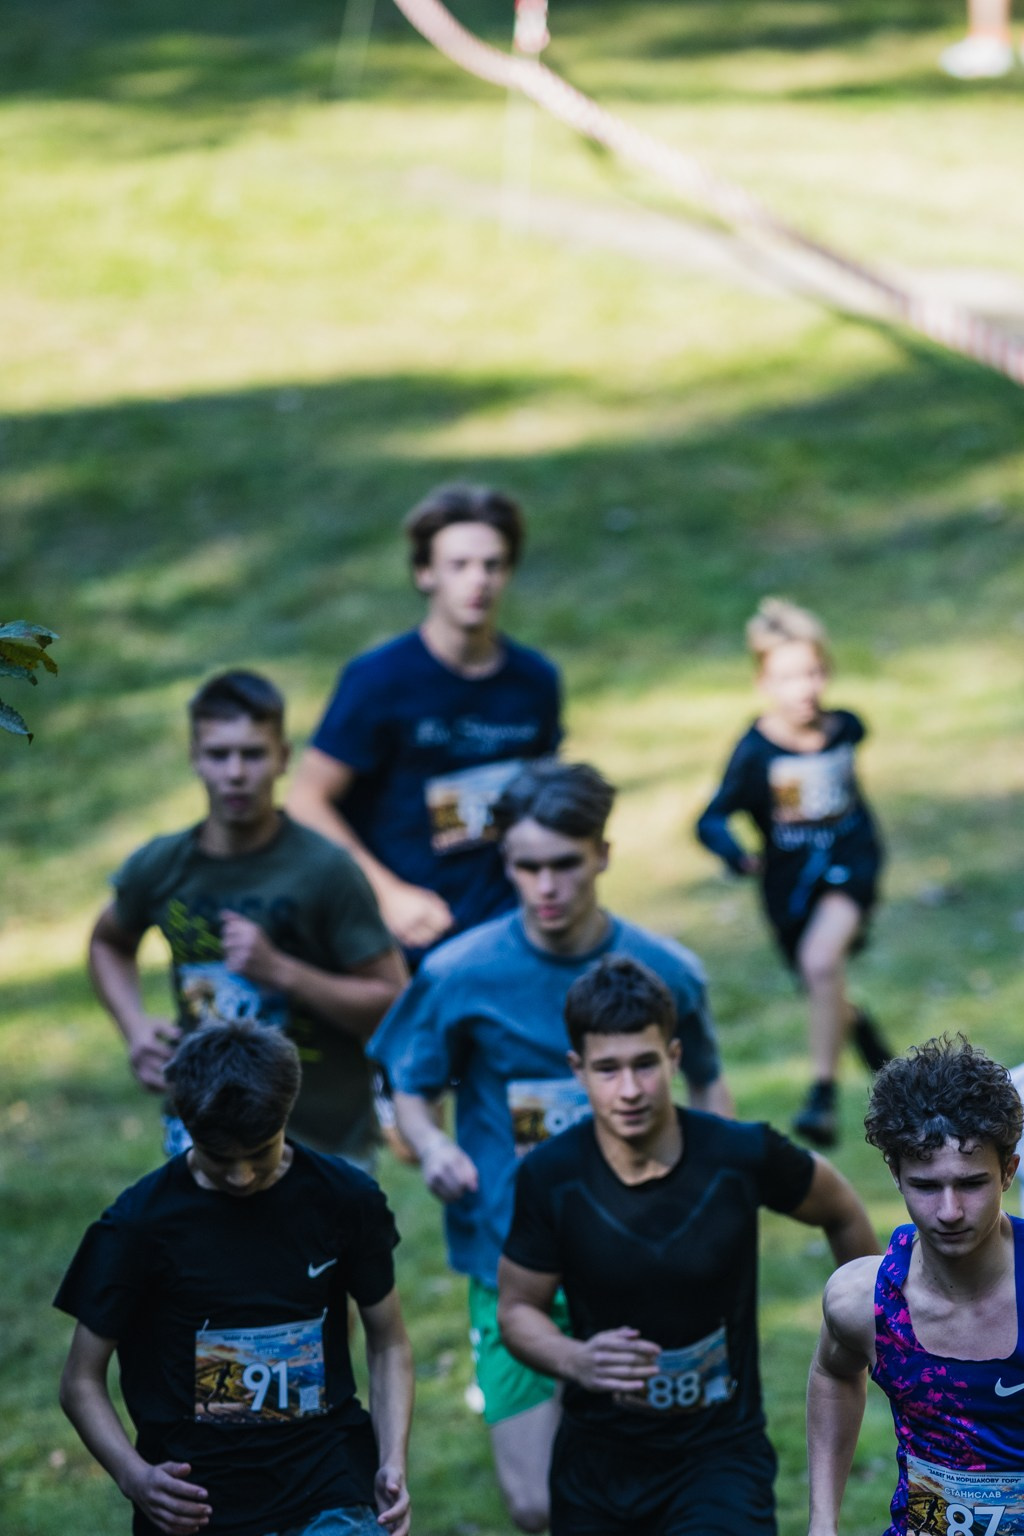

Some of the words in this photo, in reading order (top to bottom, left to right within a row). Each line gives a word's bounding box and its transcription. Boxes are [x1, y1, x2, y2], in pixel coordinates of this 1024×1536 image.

[242, 1361, 288, 1411] 91
[648, 1371, 700, 1409] 88
[944, 1487, 1002, 1499] СТАНИСЛАВ
